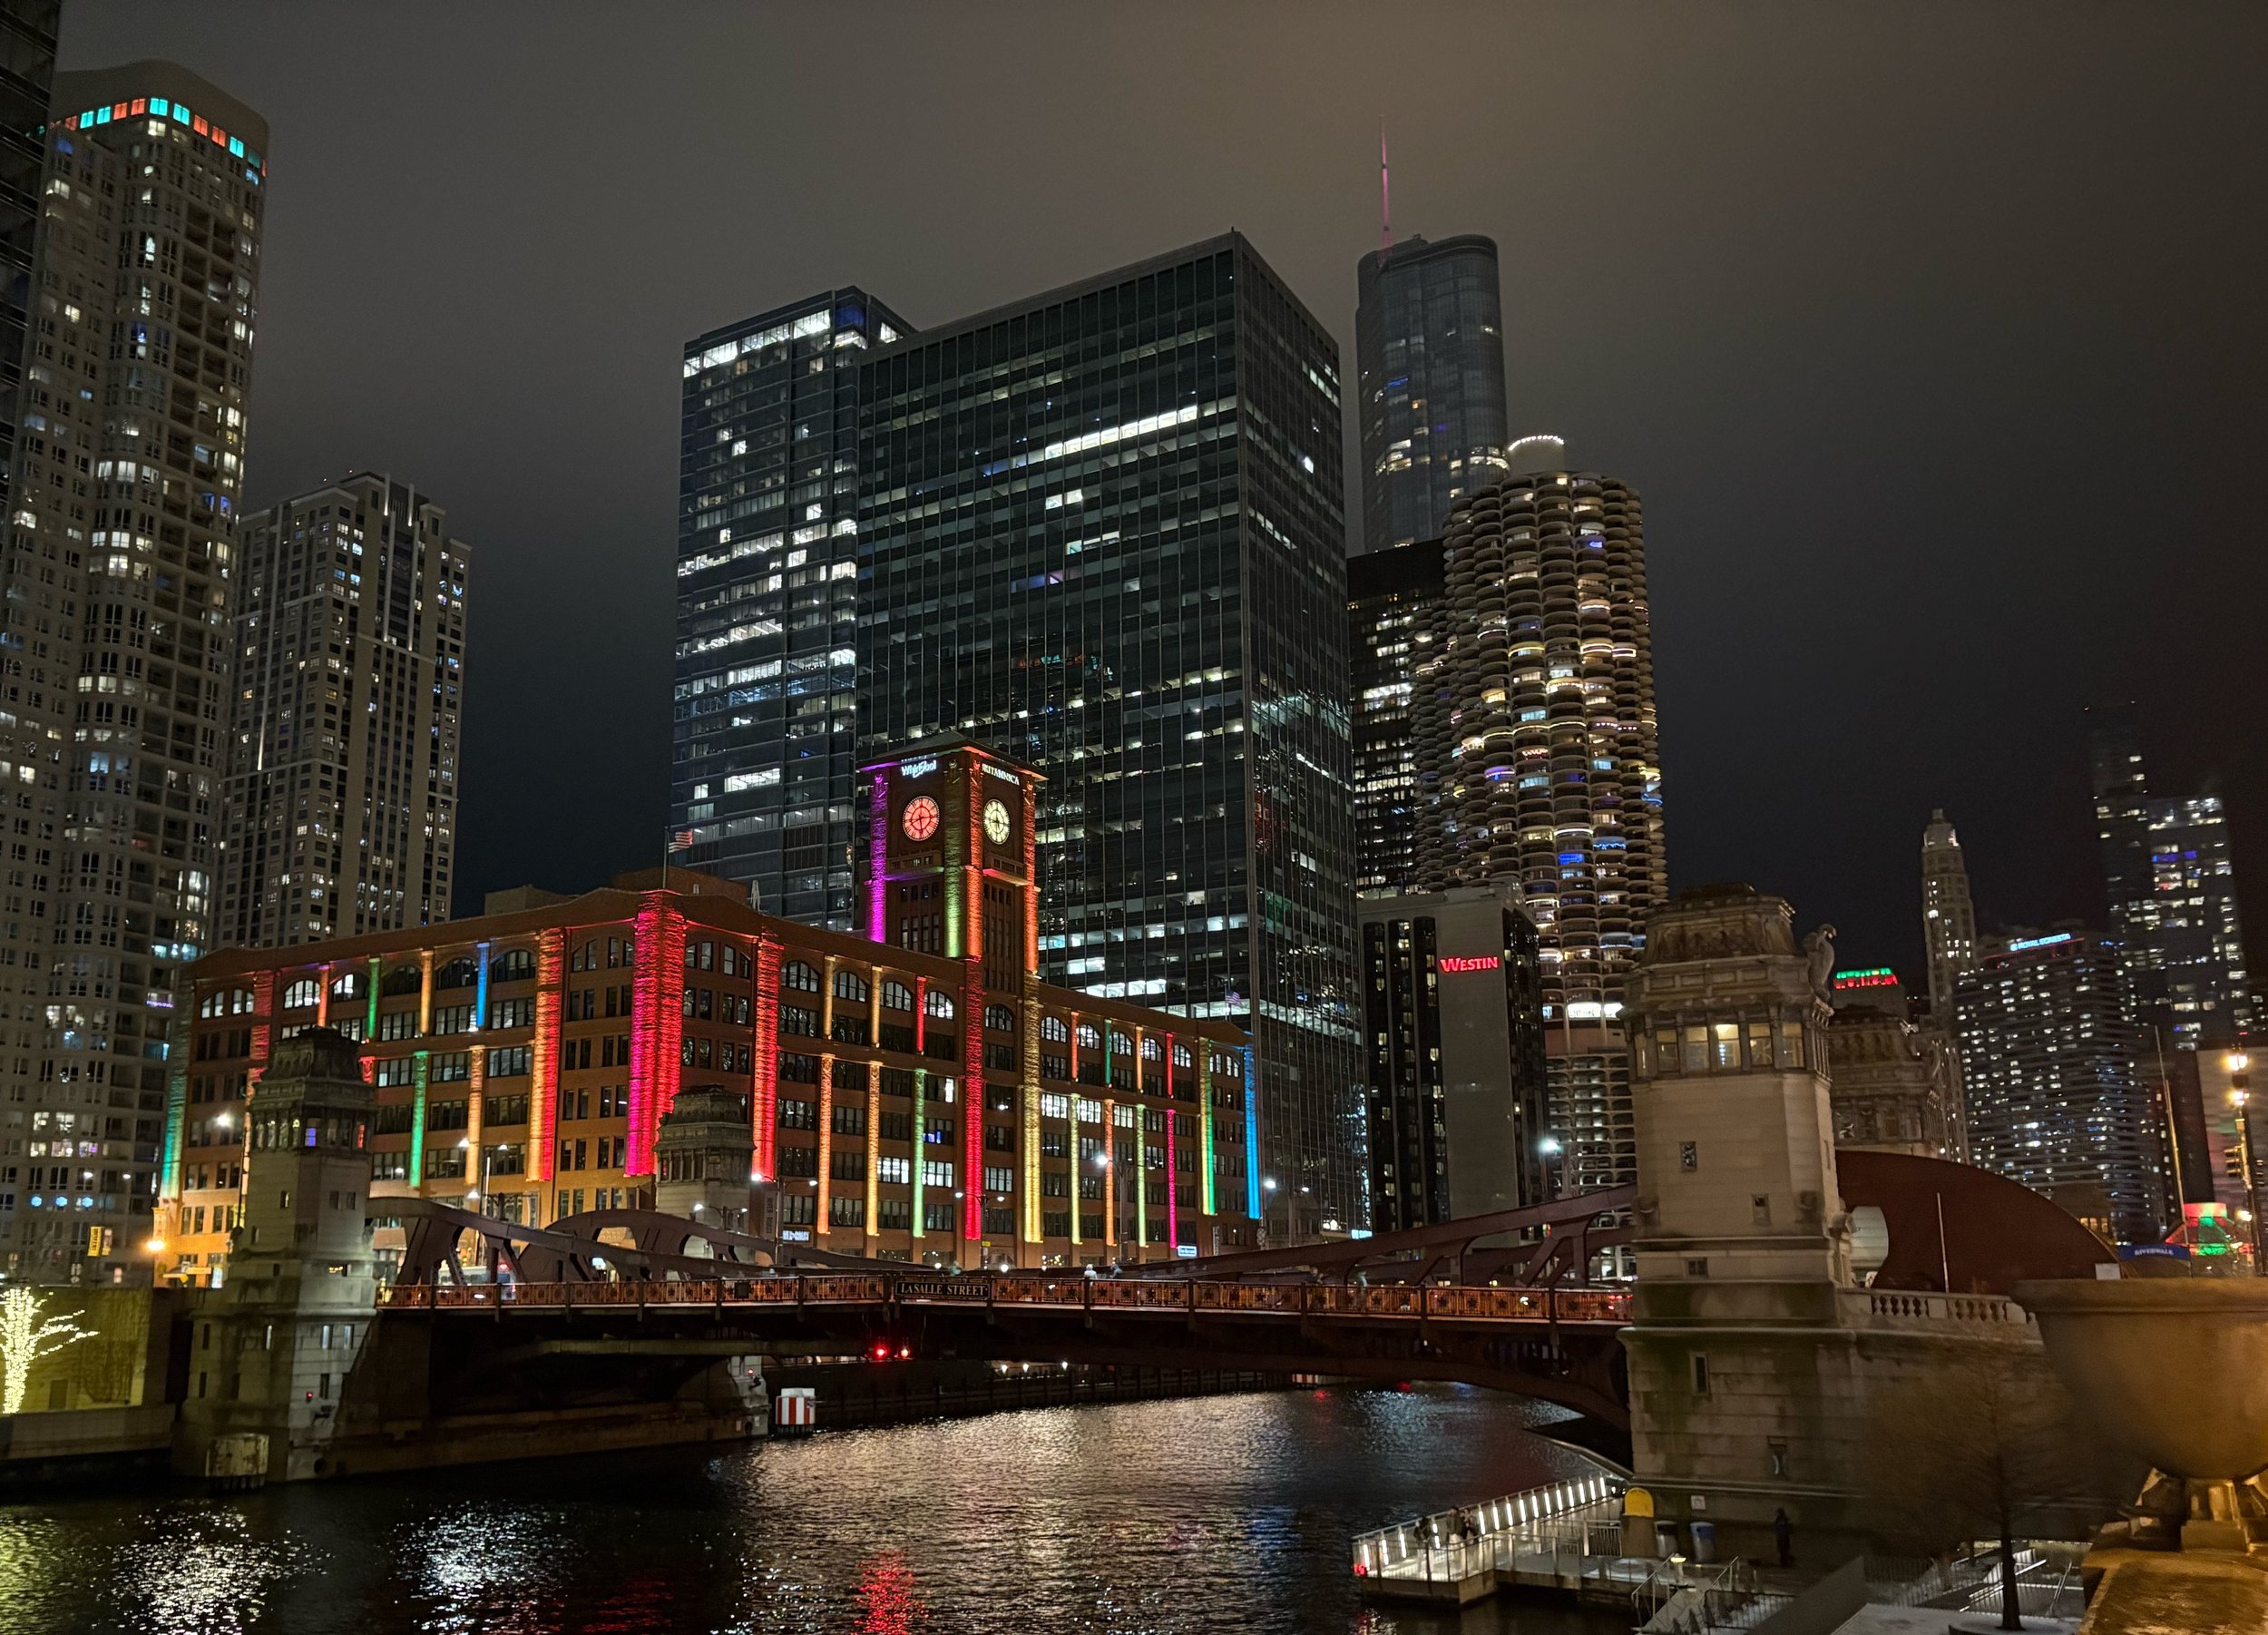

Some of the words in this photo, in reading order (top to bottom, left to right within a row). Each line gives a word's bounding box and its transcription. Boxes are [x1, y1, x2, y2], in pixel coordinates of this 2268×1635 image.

[901, 759, 937, 778] Whirlpool
[982, 763, 1021, 786] BRITANNICA
[1440, 956, 1499, 973] WESTIN
[2134, 1248, 2175, 1257] RIVERWALK
[947, 1285, 986, 1297] STREET
